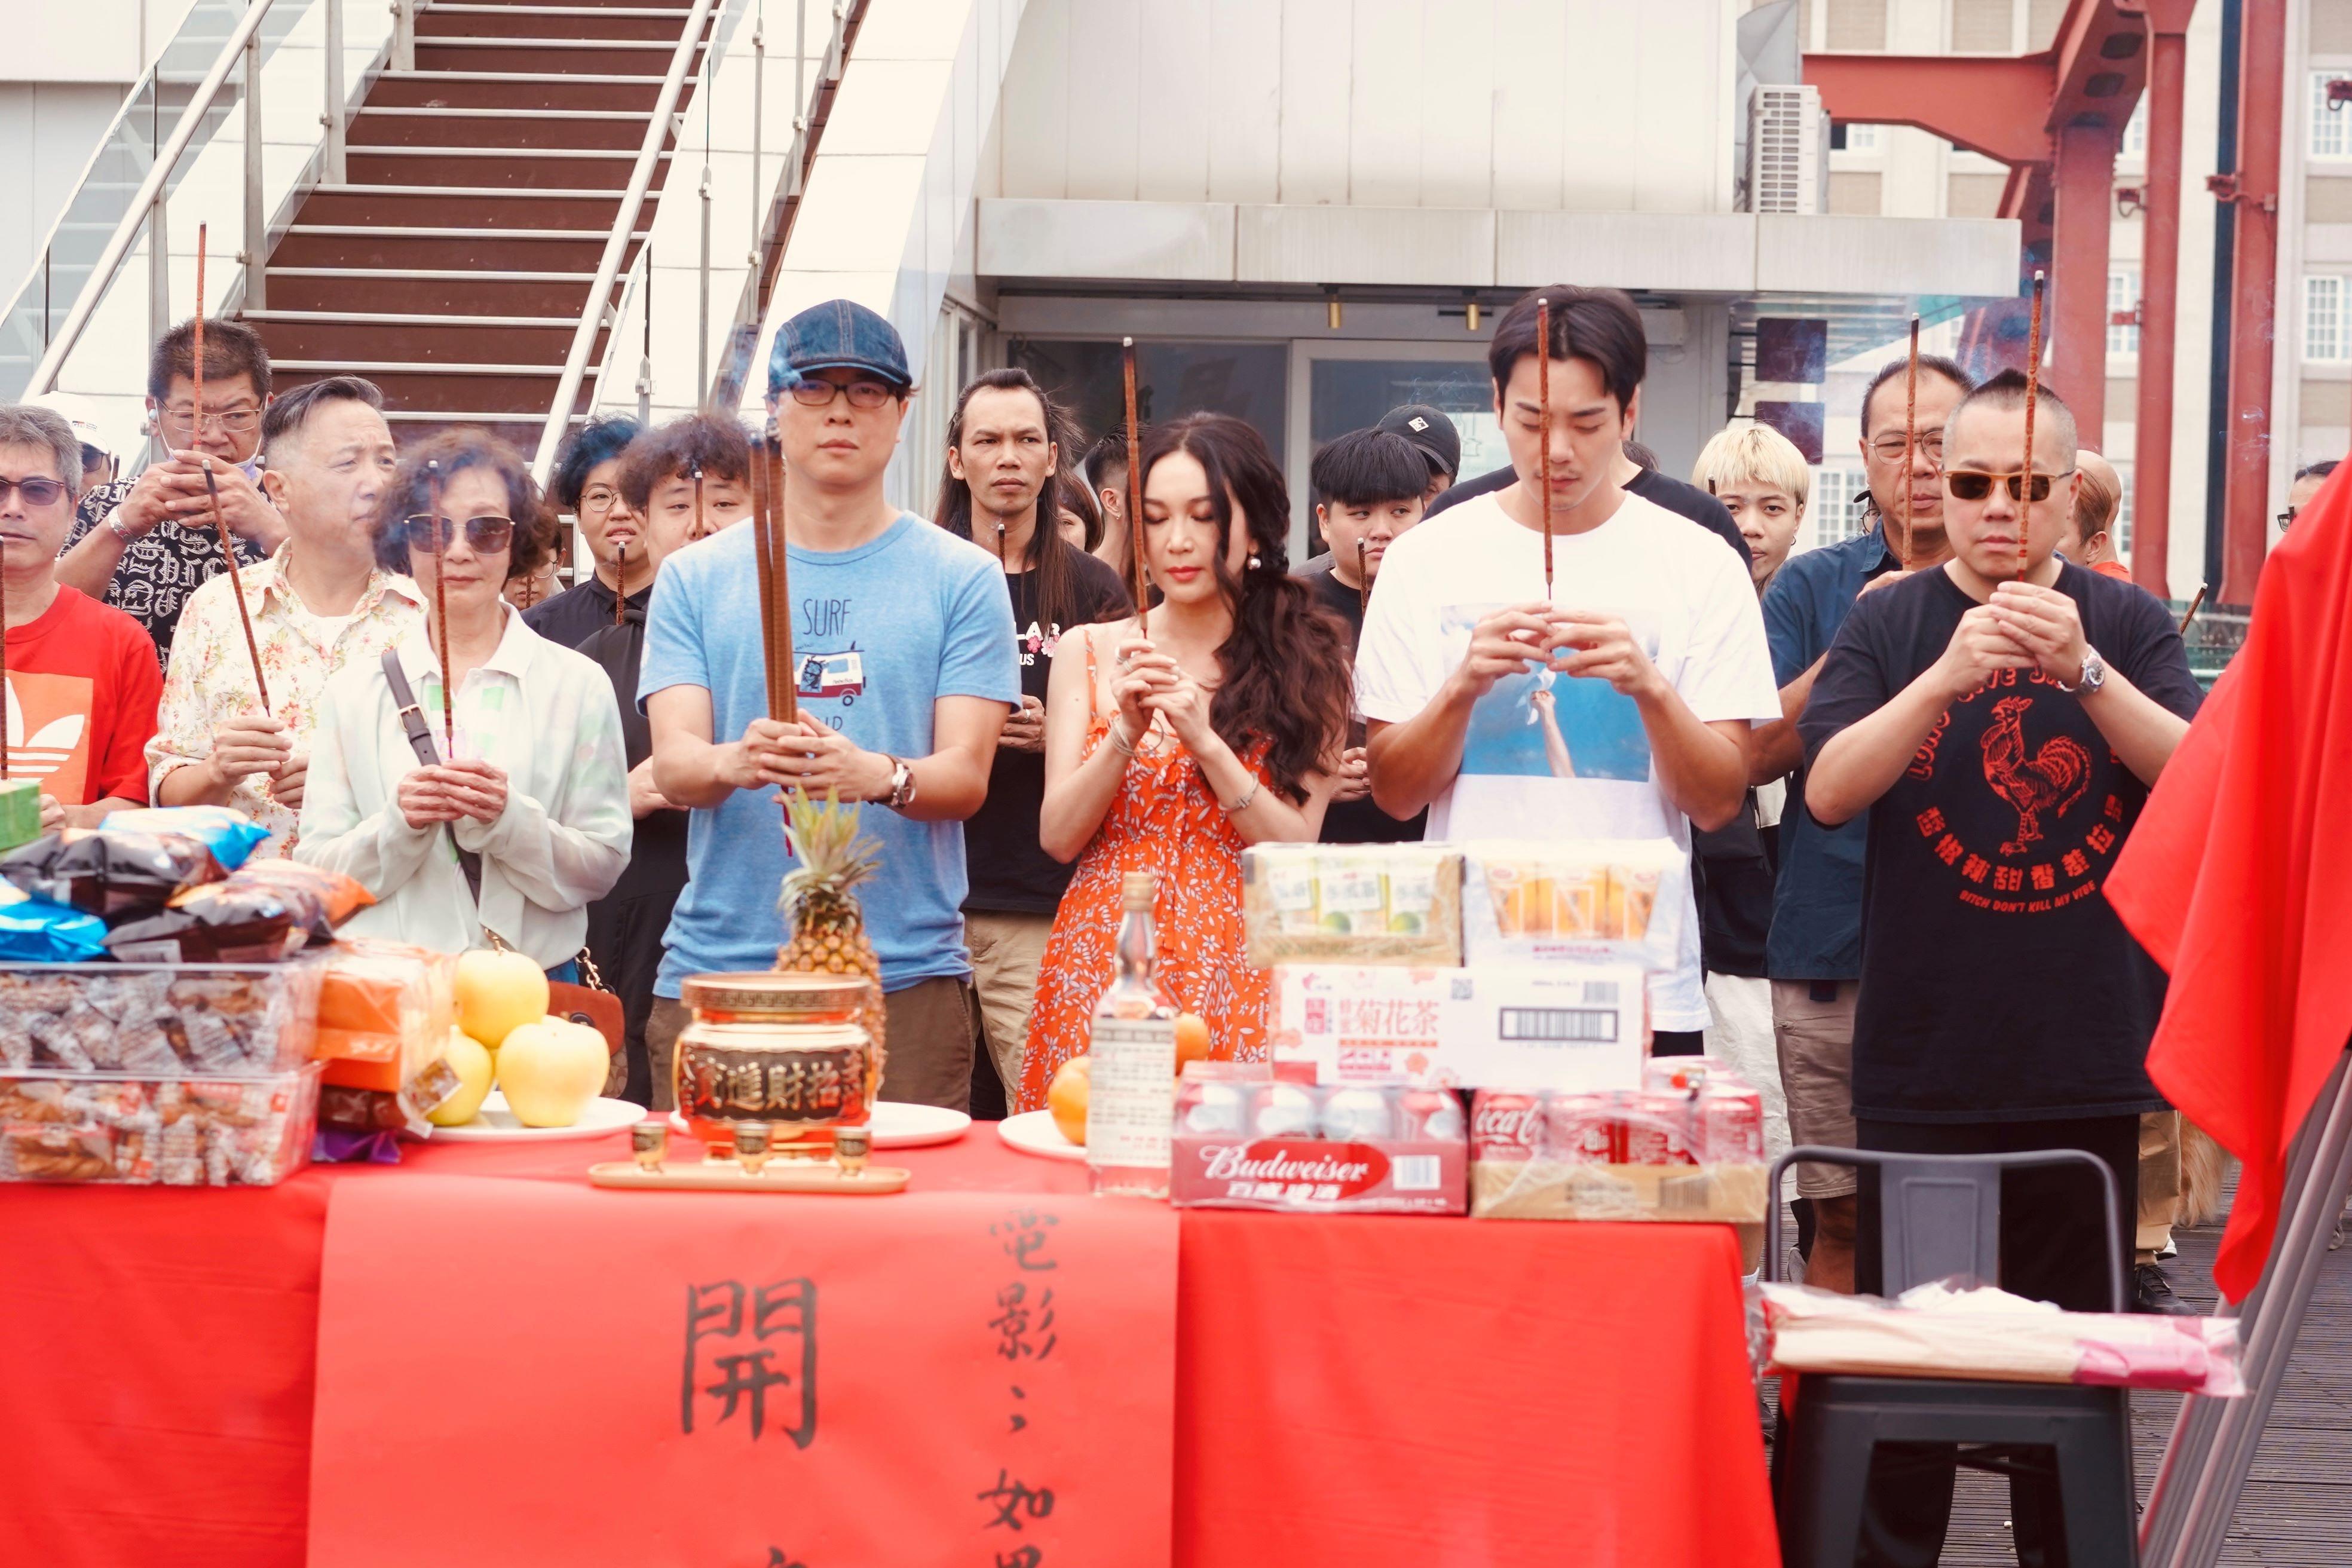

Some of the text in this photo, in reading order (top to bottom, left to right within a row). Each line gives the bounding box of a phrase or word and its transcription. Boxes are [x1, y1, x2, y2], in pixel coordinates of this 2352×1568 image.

[803, 598, 852, 636] SURF
[1959, 890, 1991, 909] BITCH
[1992, 900, 2026, 913] DON'T
[2028, 899, 2051, 912] KILL
[2054, 893, 2070, 908] MY
[1199, 1146, 1369, 1181] Budweiser
